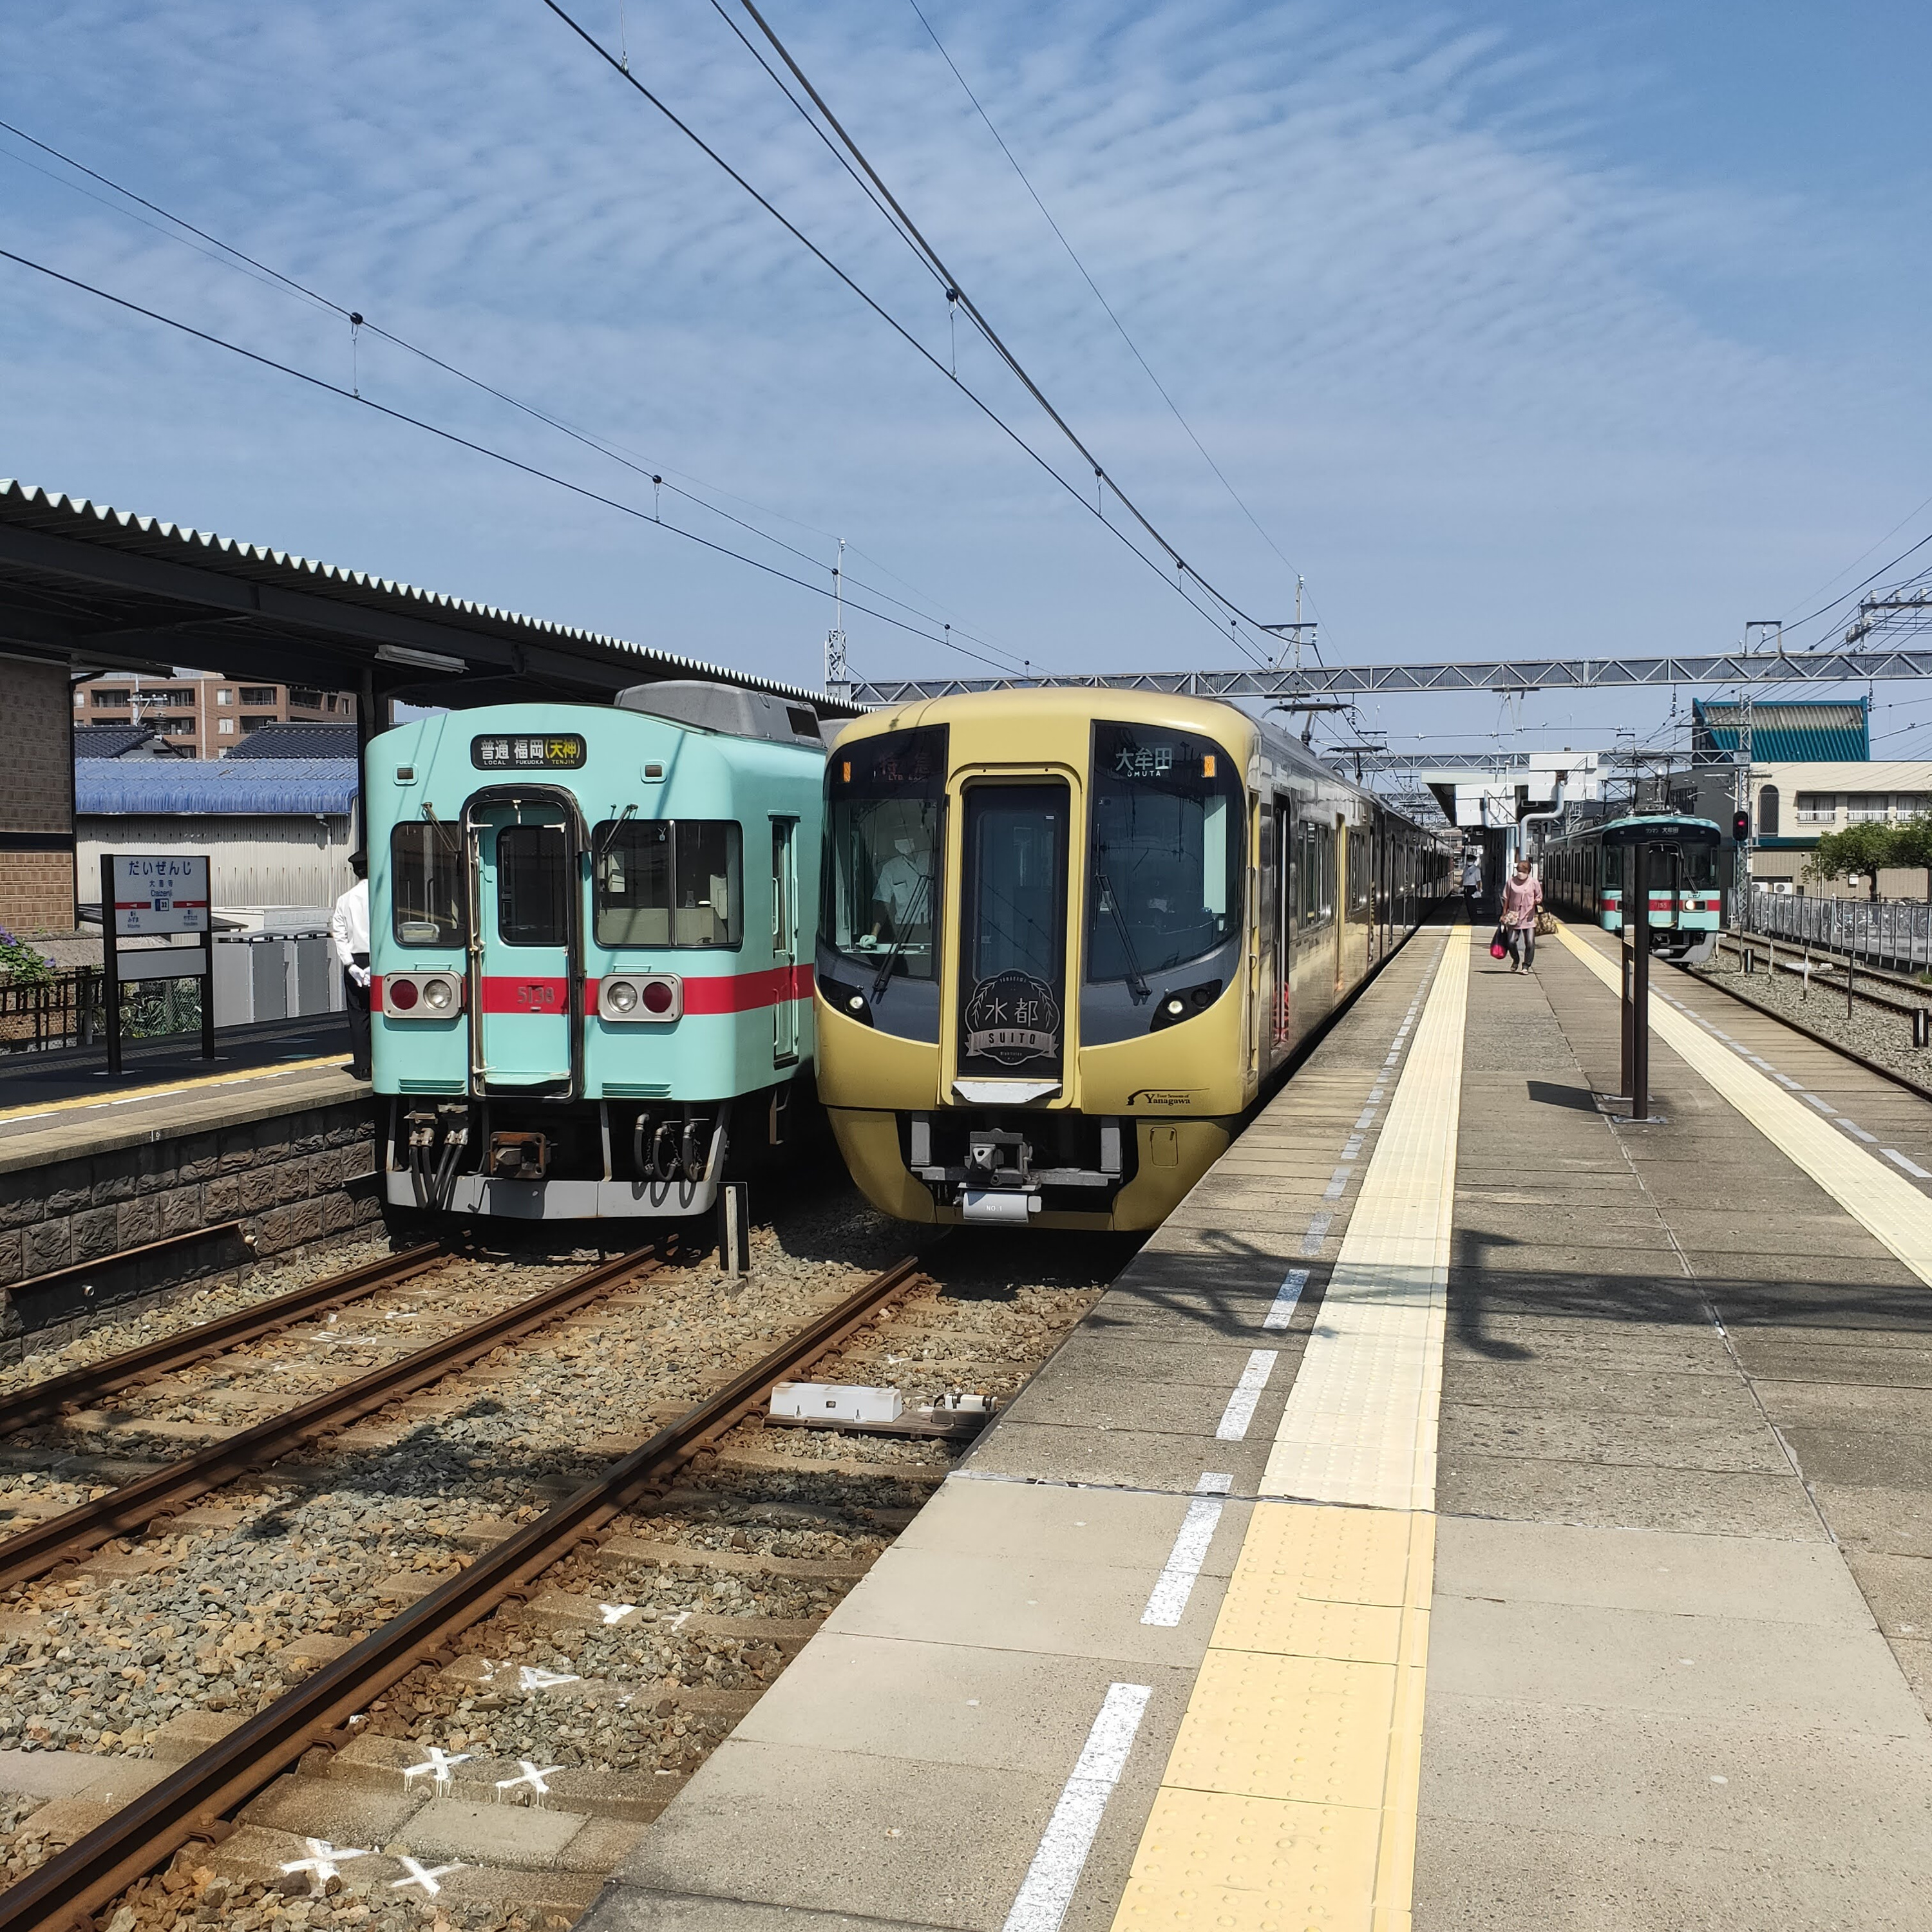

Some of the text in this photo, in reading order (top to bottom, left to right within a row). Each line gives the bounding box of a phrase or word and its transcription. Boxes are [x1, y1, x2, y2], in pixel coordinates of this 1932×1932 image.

[481, 740, 509, 760] 普通
[1115, 748, 1172, 771] 大牟田
[129, 860, 192, 876] だいぜんじ
[517, 987, 554, 1004] 5138
[985, 997, 1038, 1027] 水都
[989, 1032, 1036, 1045] SUITO
[1144, 1094, 1191, 1106] Yanagawa
